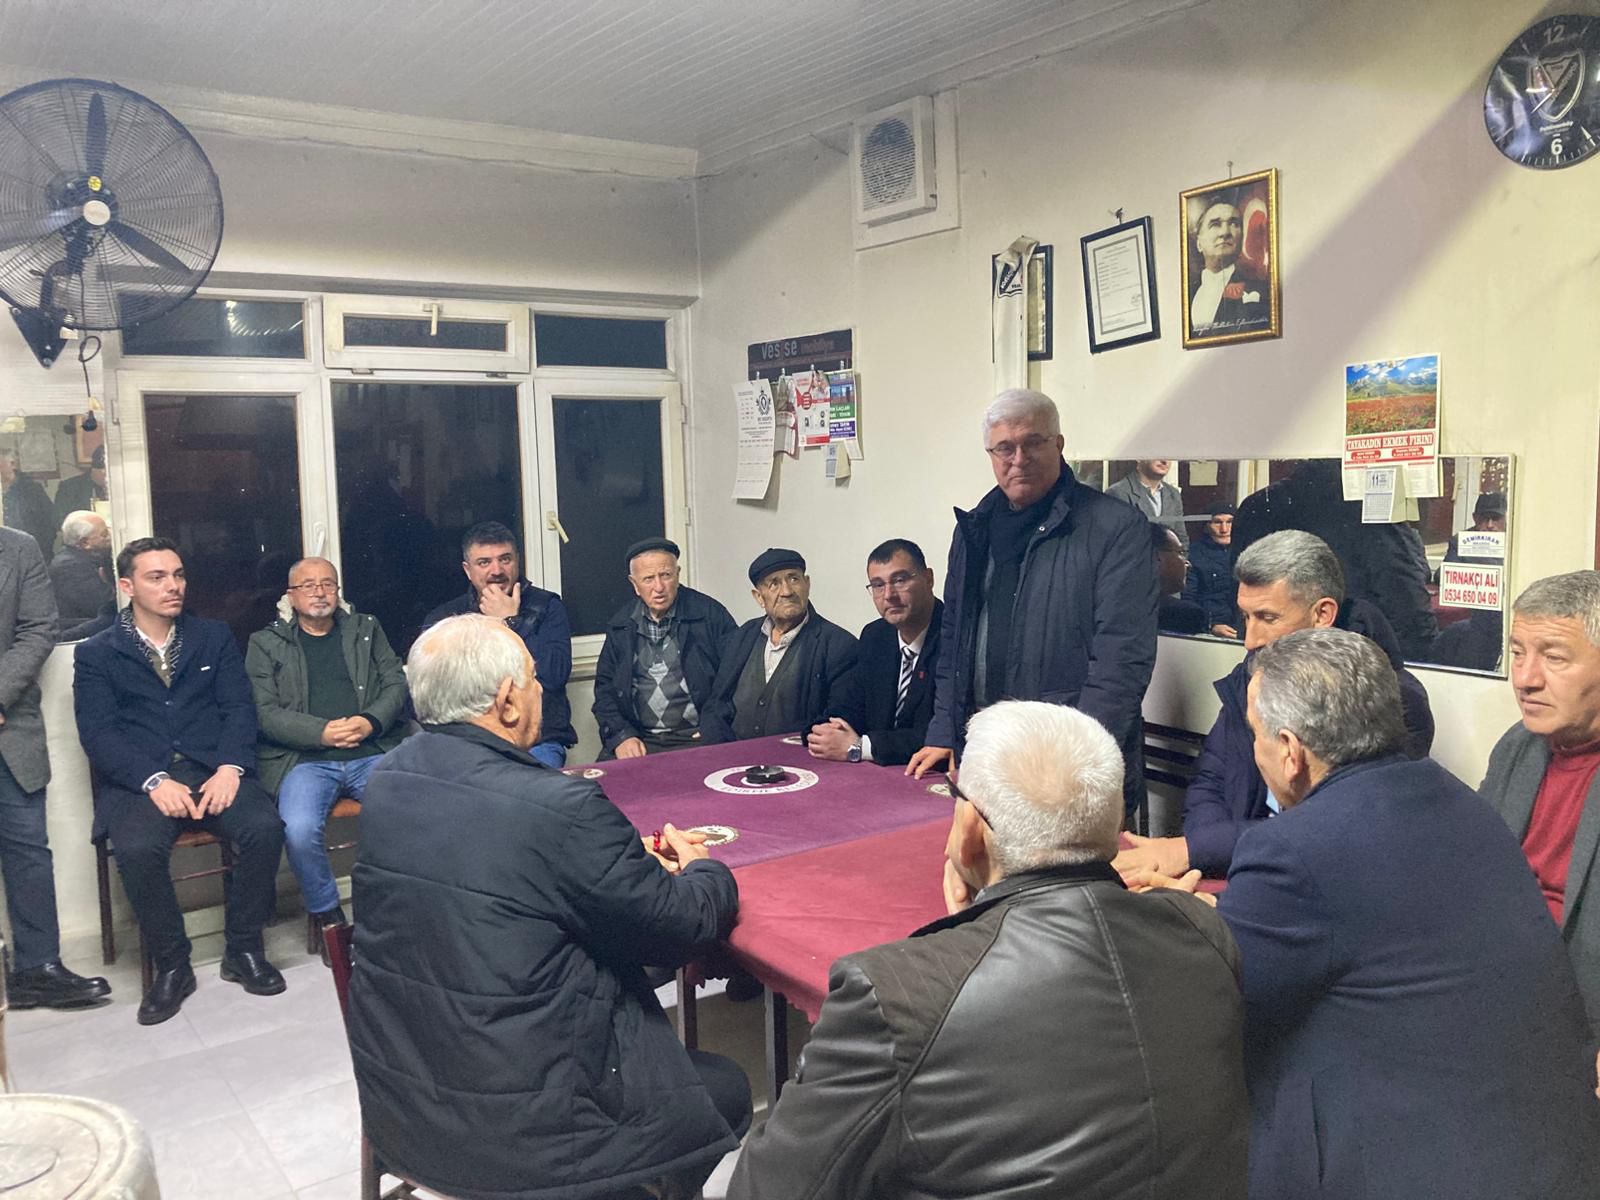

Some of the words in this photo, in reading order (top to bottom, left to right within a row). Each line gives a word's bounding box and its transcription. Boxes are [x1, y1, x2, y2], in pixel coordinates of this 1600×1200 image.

[1544, 24, 1565, 44] 12
[1551, 138, 1563, 155] 6
[1382, 436, 1408, 448] EKMEK
[1372, 473, 1379, 486] 11
[1445, 570, 1483, 589] TIRNAKÇI
[1485, 571, 1498, 587] ALİ
[1444, 588, 1461, 601] 0534
[1463, 590, 1476, 603] 650
[1477, 591, 1486, 604] 04
[1488, 592, 1497, 605] 09
